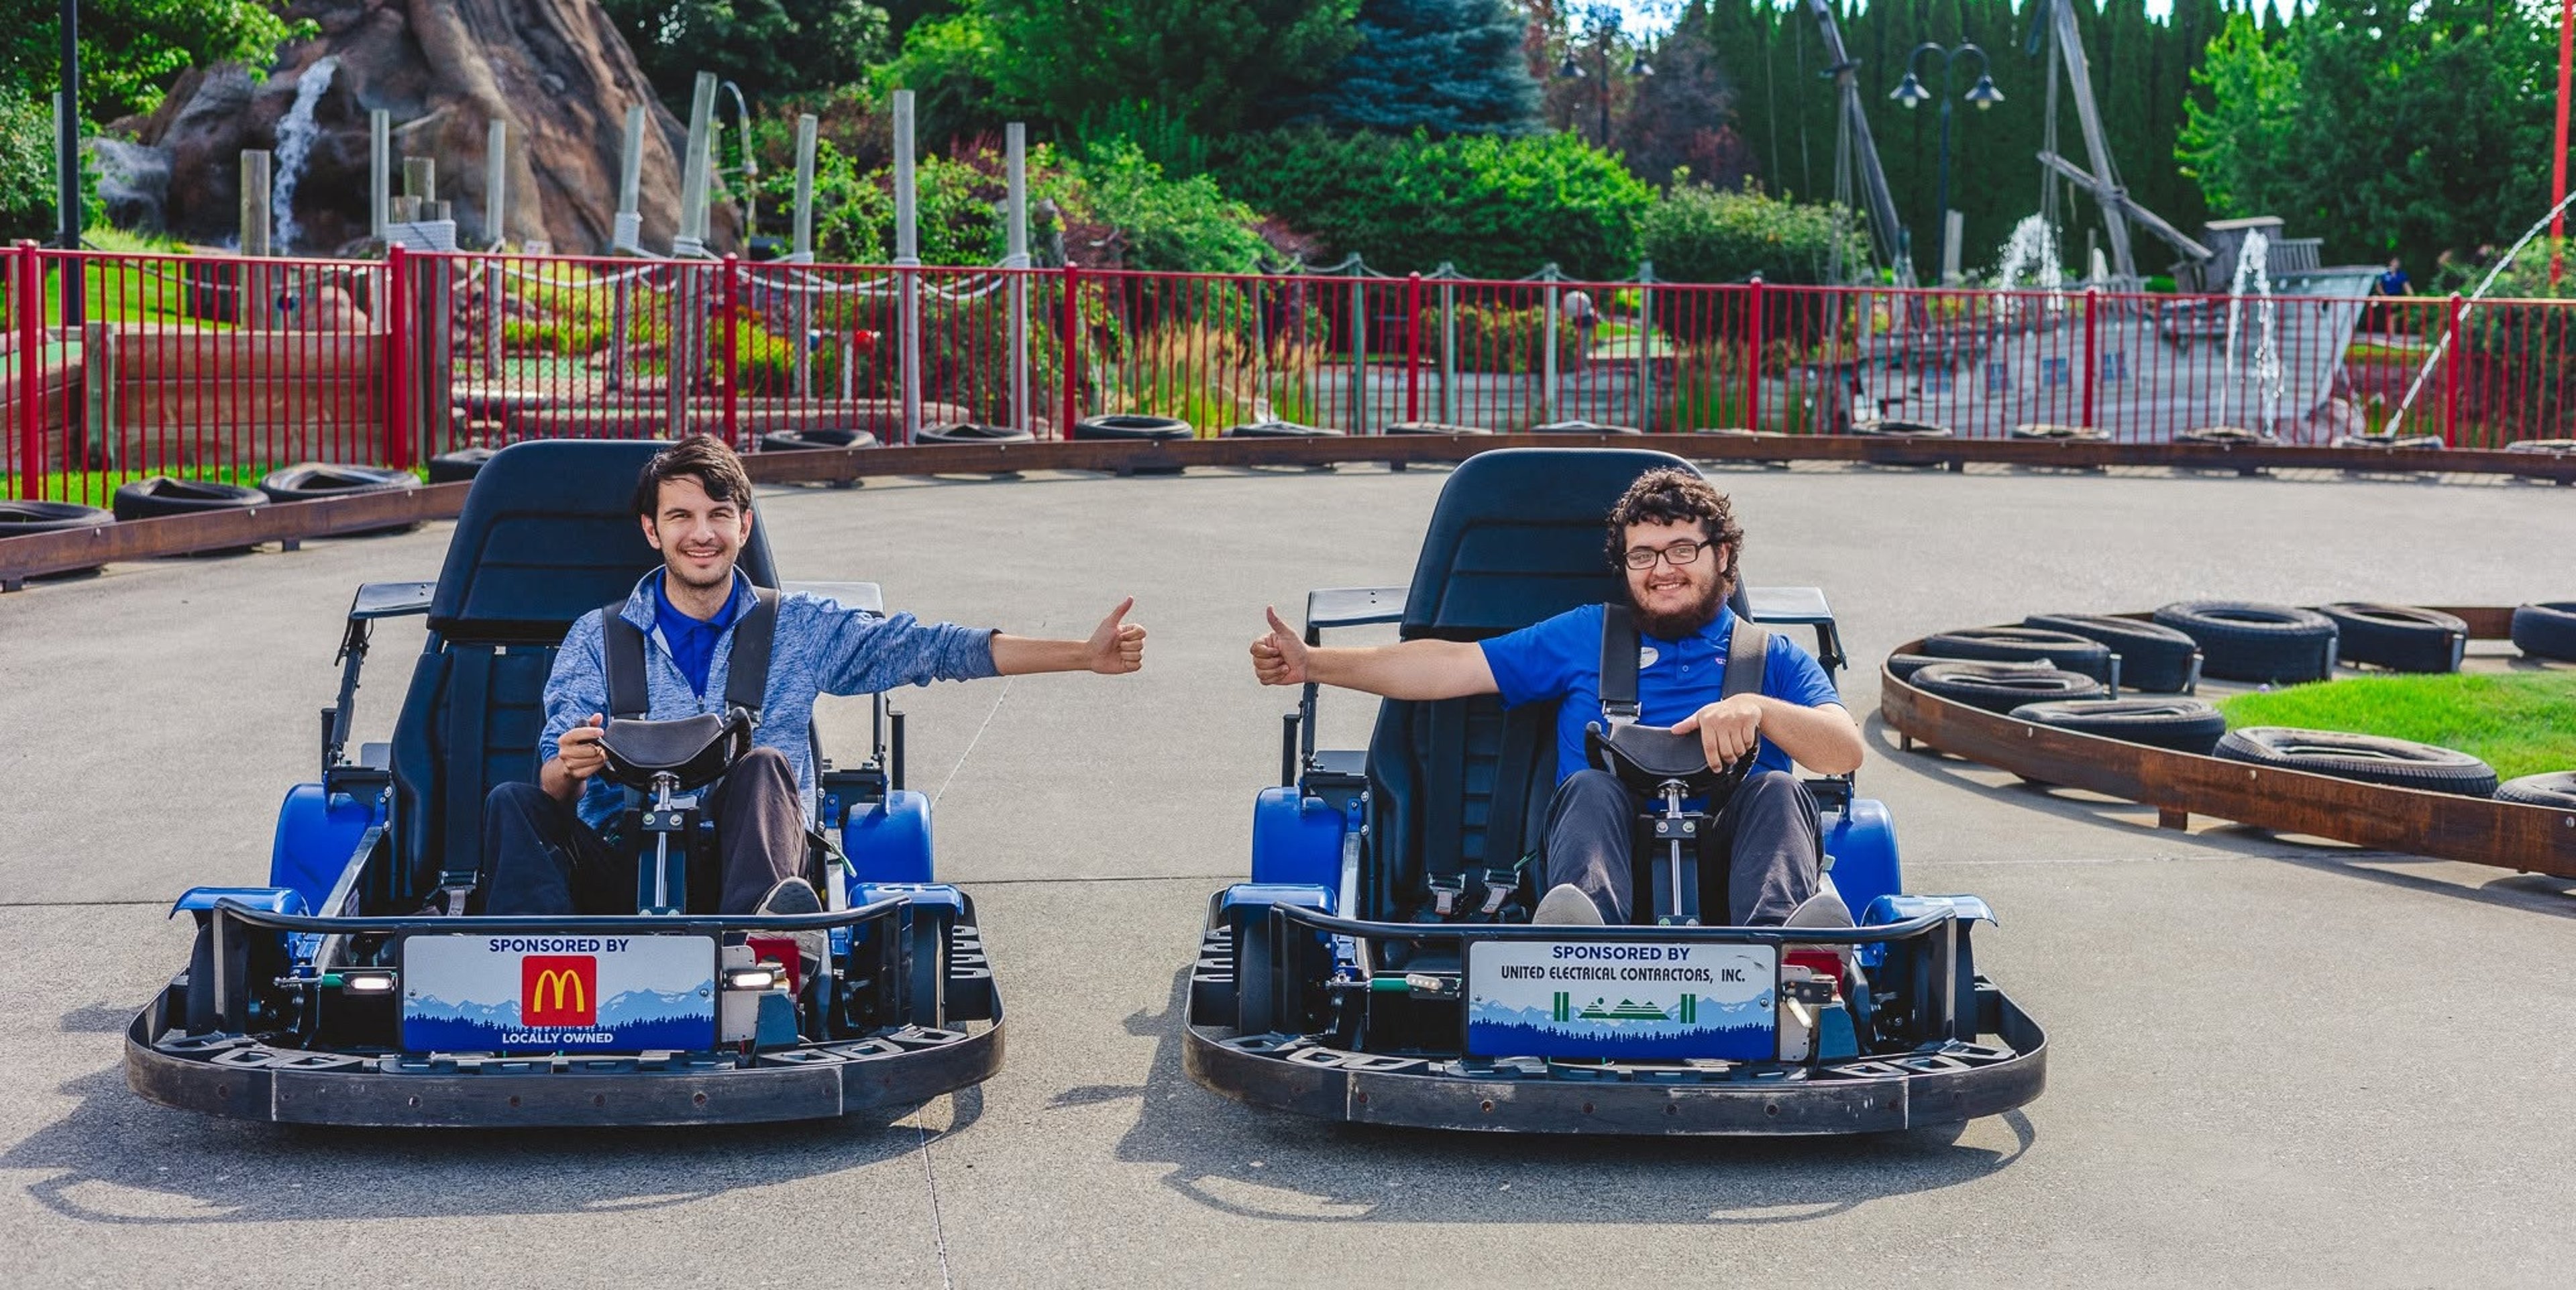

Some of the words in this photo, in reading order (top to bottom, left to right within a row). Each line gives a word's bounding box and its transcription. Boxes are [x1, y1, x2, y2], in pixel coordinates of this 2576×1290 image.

[489, 938, 601, 953] SPONSORED
[606, 938, 630, 953] BY
[1552, 945, 1662, 961] SPONSORED
[1668, 947, 1691, 961] BY
[1501, 965, 1545, 979] UNITED
[1549, 966, 1617, 981] ELECTRICAL
[1620, 967, 1713, 984] CONTRACTORS,
[1721, 969, 1746, 983] INC.
[502, 1032, 559, 1044] LOCALLY
[563, 1033, 613, 1044] OWNED
